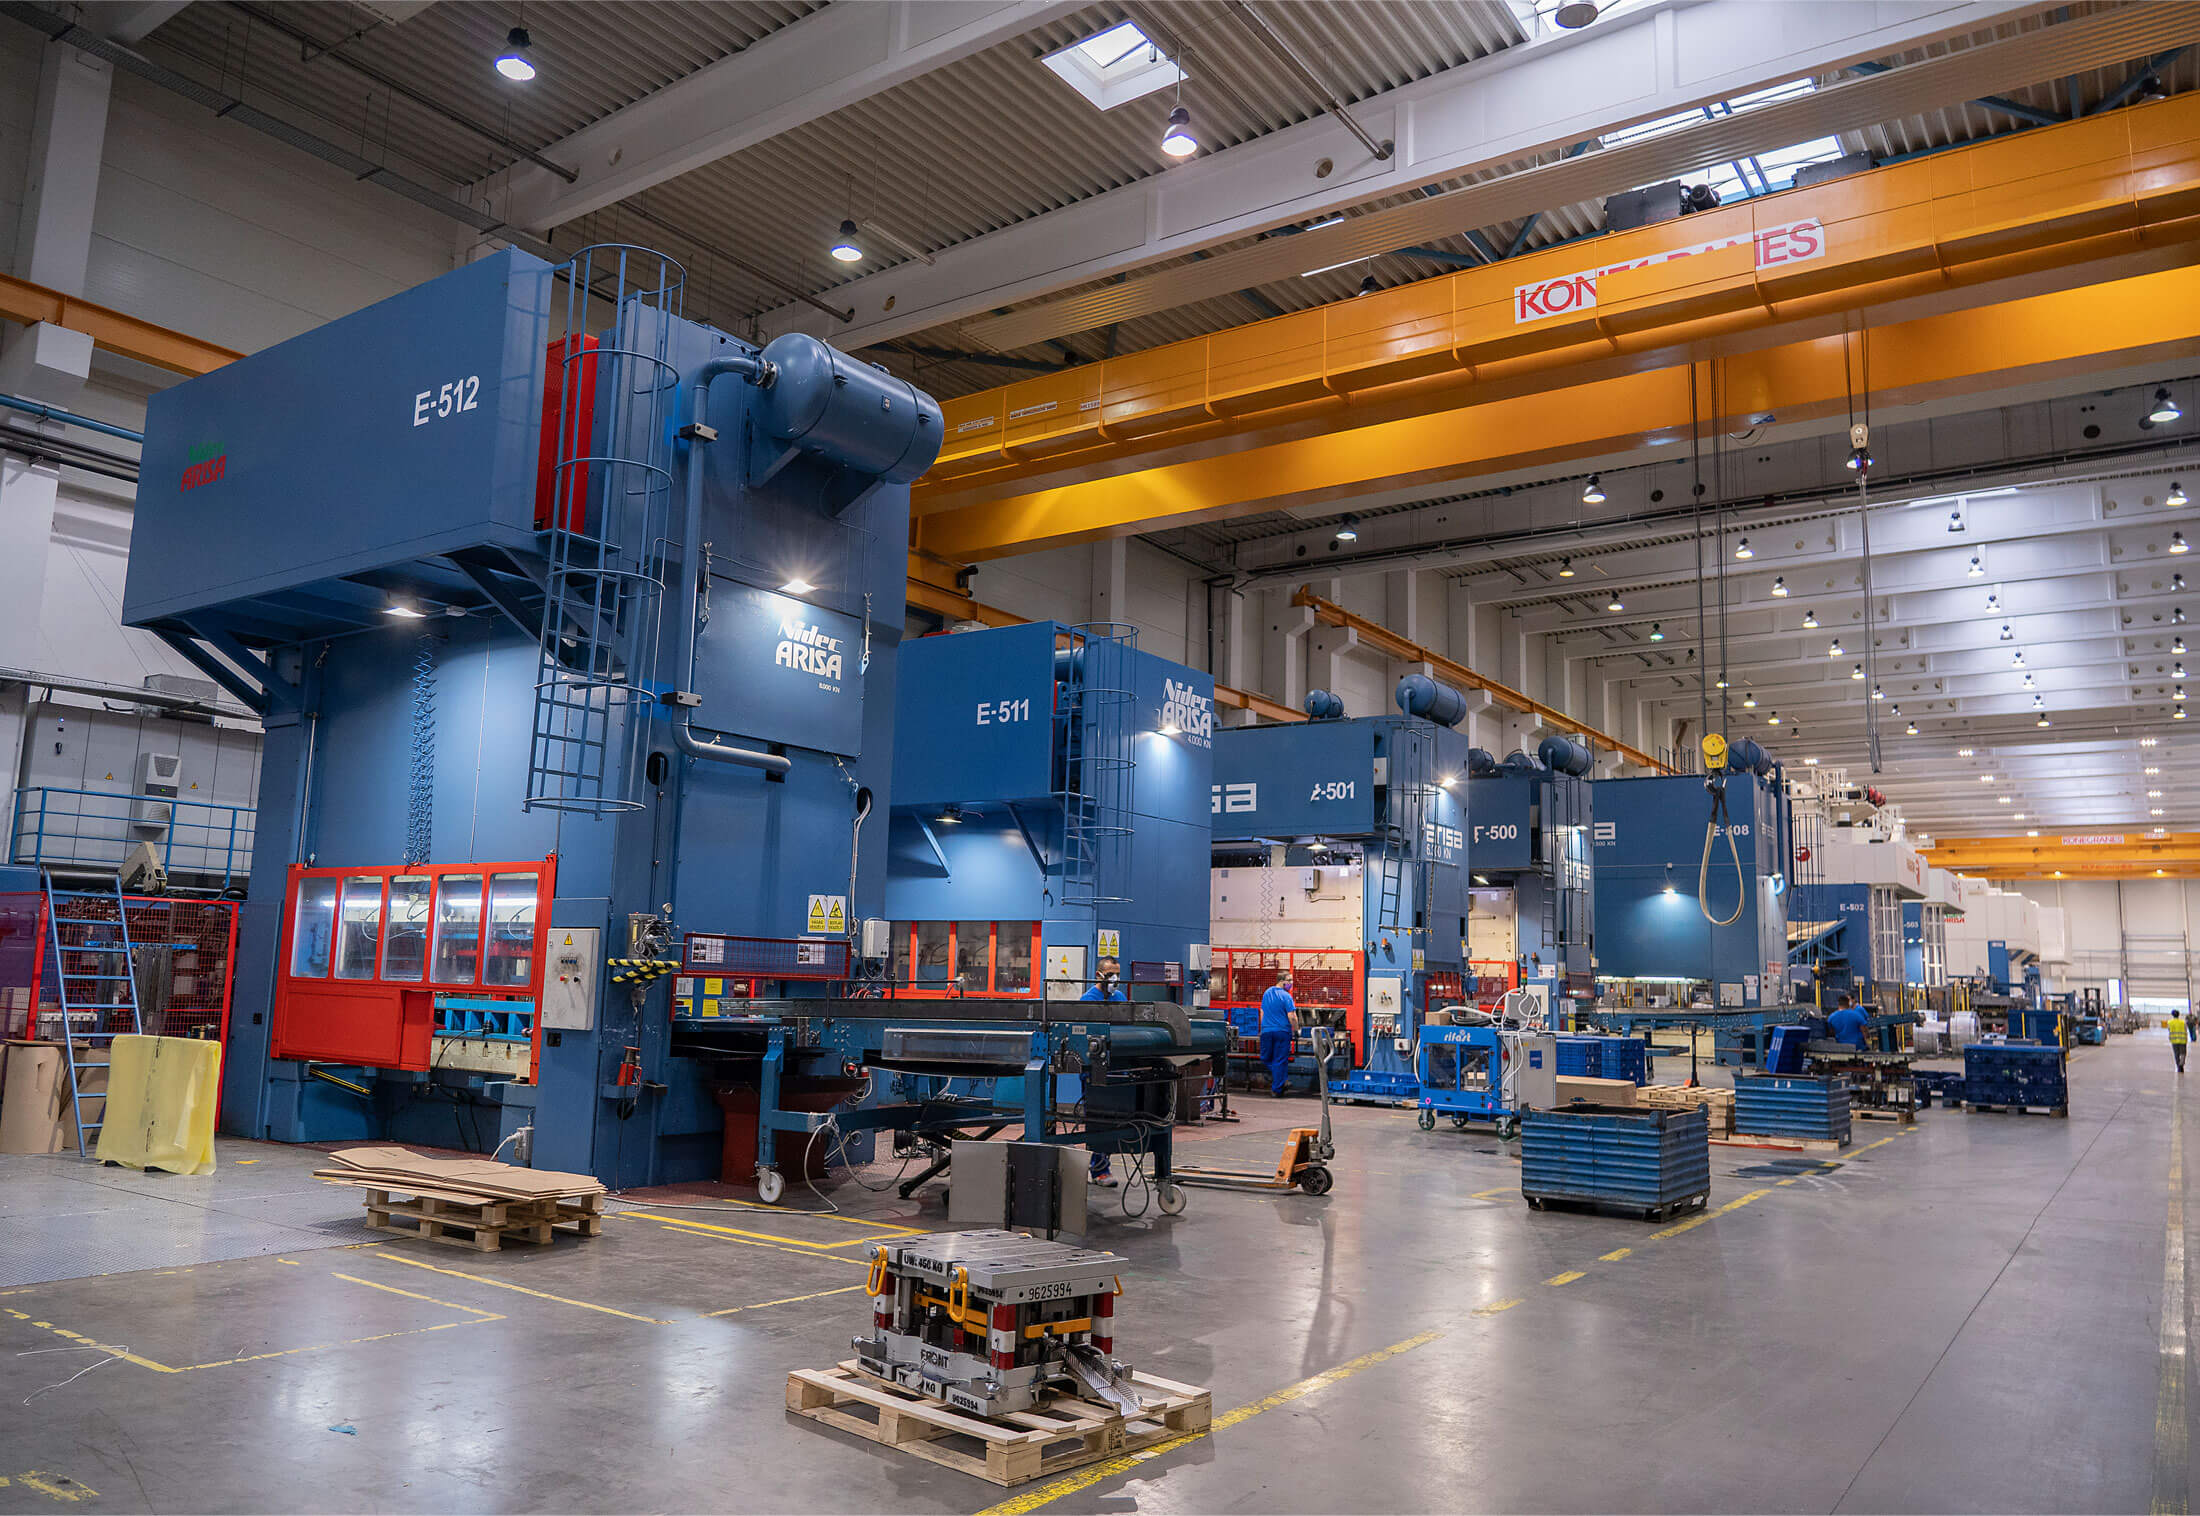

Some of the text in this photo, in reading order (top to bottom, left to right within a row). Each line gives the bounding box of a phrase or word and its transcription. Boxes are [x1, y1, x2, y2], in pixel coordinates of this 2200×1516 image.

[413, 375, 480, 427] E-512
[776, 640, 842, 680] ARISA
[1162, 678, 1212, 712] Nidec
[976, 698, 1029, 725] E-511
[1162, 701, 1212, 739] ARISA
[1028, 1283, 1073, 1300] 9625994
[920, 1349, 949, 1369] FRONT
[925, 1382, 936, 1393] KG
